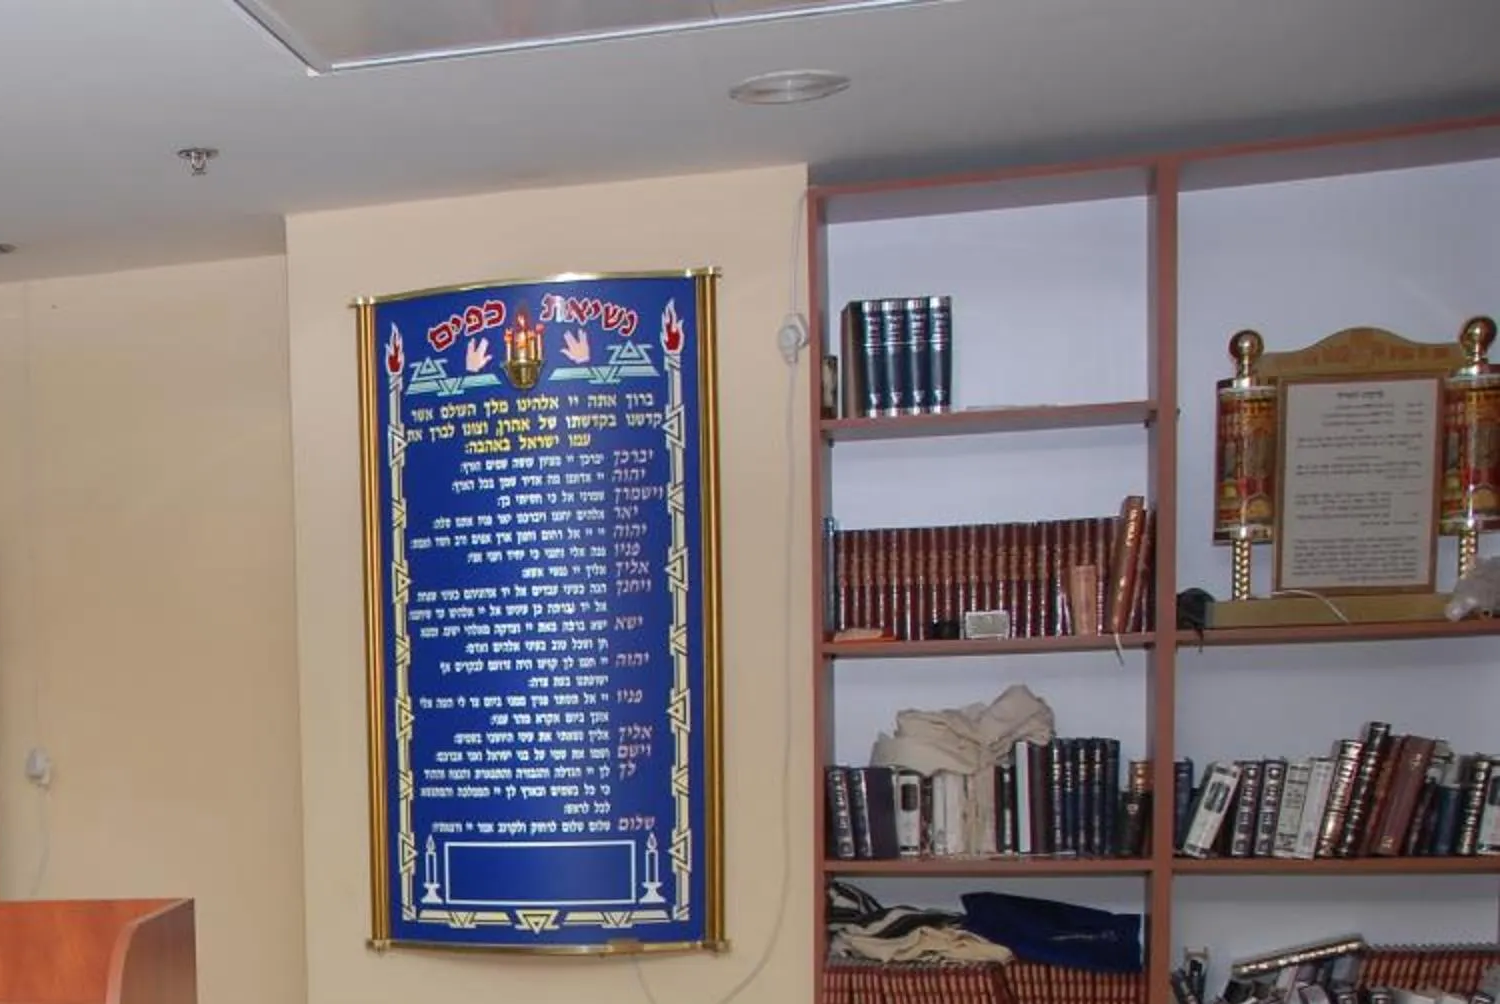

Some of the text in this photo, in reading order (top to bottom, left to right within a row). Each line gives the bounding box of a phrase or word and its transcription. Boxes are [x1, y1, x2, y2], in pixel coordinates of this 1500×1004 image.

[428, 293, 638, 350] נשיאת כפים
[484, 398, 508, 417] מלך
[588, 393, 616, 409] אתה
[626, 392, 653, 408] ברוך
[539, 414, 556, 431] של
[519, 433, 559, 450] ישראל
